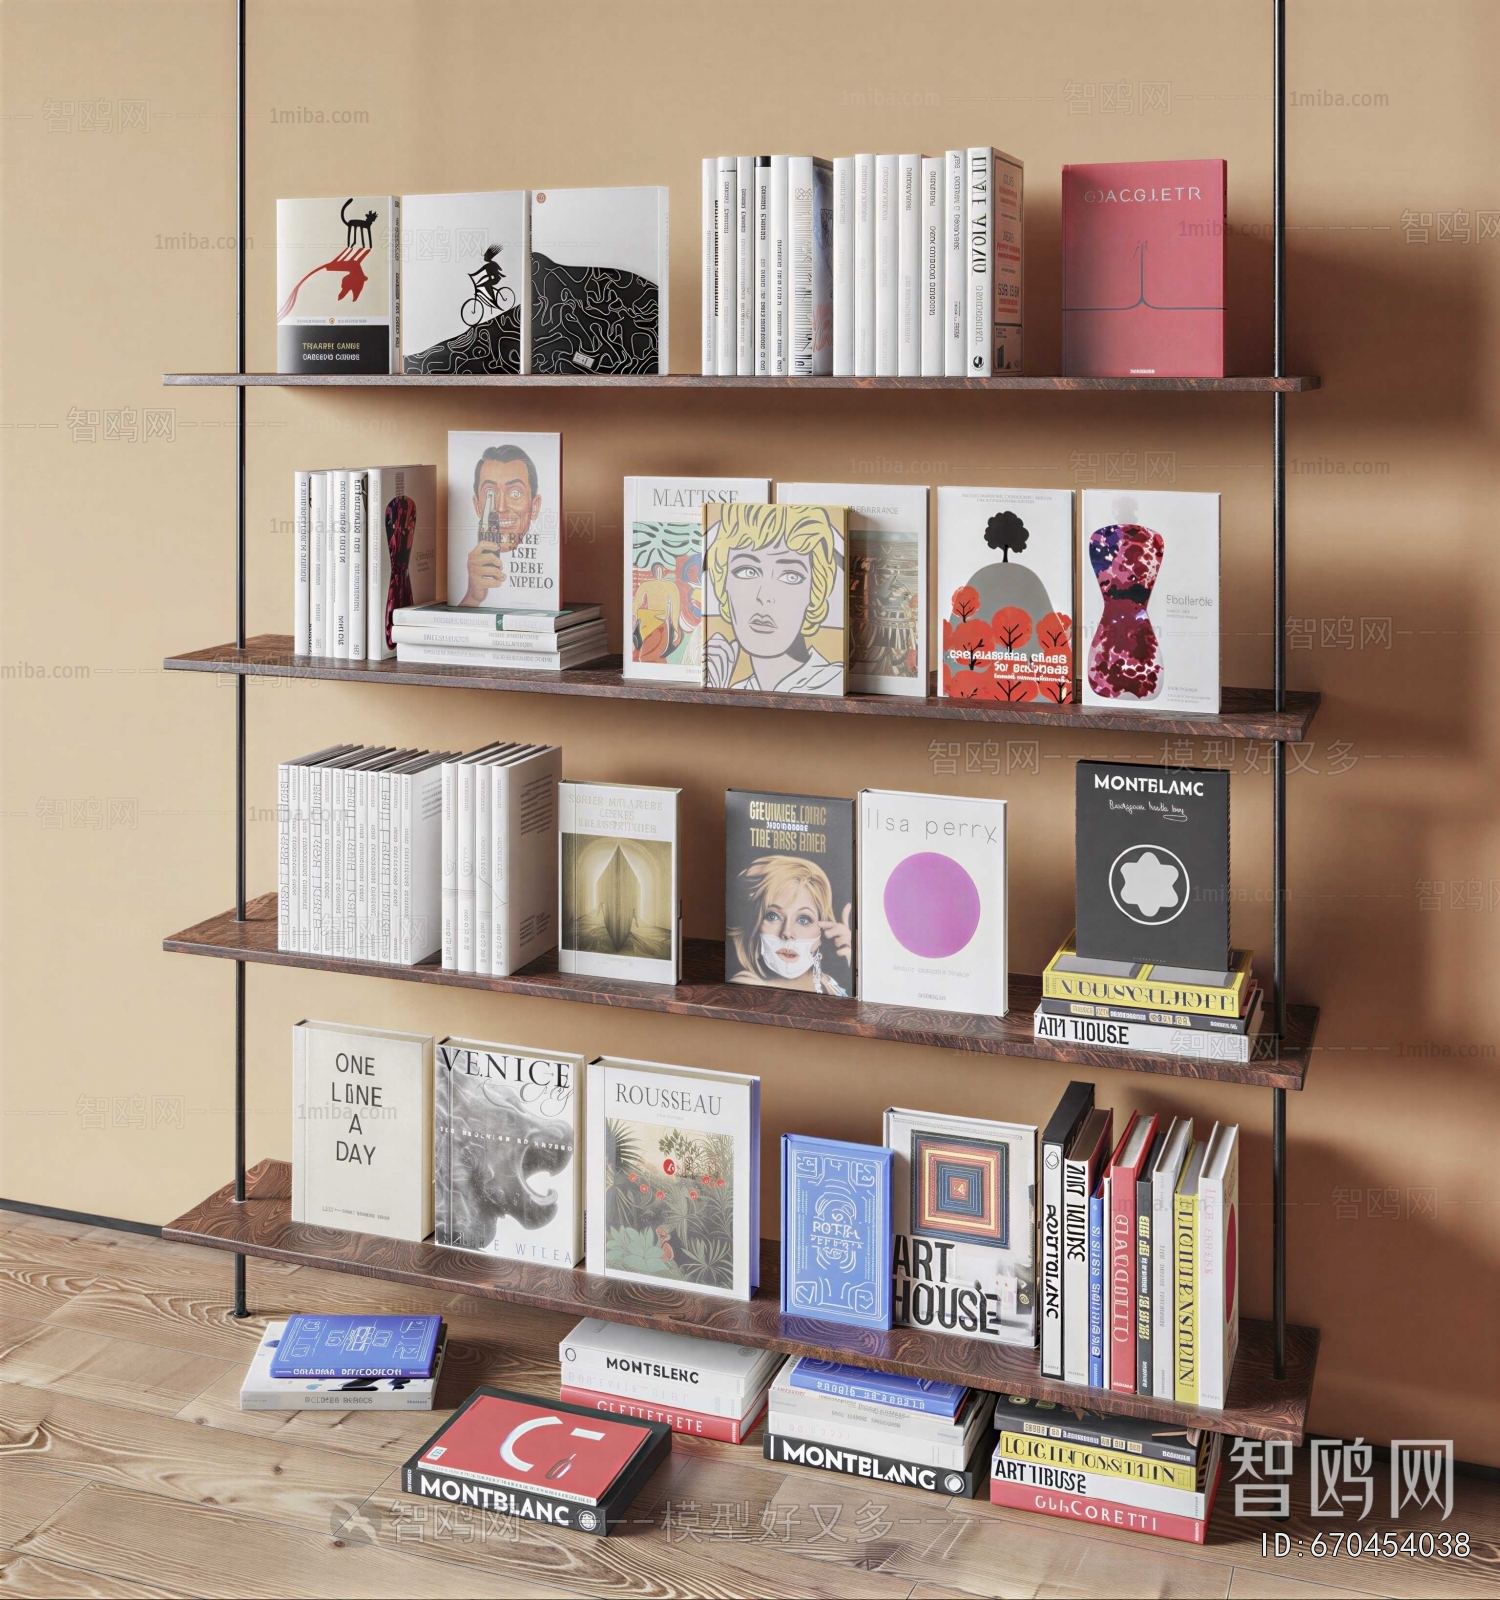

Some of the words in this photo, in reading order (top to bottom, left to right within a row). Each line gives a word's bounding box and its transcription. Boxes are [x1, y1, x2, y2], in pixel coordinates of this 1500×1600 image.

[335, 1052, 376, 1077] ONE
[615, 1082, 723, 1117] ROUSSEAU
[348, 1113, 363, 1135] A
[336, 1140, 377, 1166] DAY
[892, 1234, 956, 1284] ART
[892, 1274, 1001, 1336] HOUSE
[420, 1474, 570, 1527] MONTBLANC
